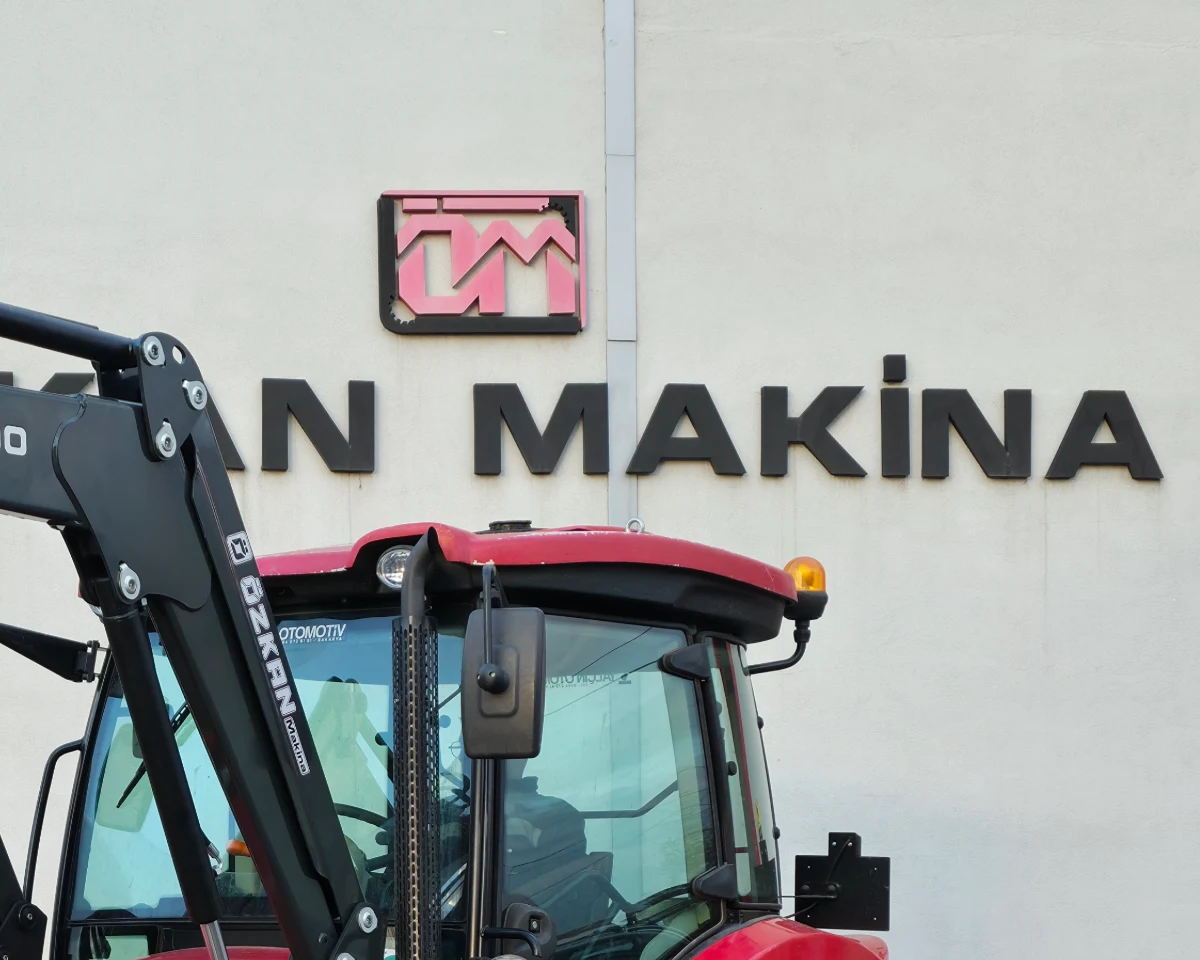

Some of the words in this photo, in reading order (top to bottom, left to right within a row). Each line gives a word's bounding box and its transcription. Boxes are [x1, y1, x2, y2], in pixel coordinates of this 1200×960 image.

[473, 354, 1164, 481] MAKİNA
[239, 575, 297, 717] ÖZKAN
[284, 717, 309, 775] Makina
